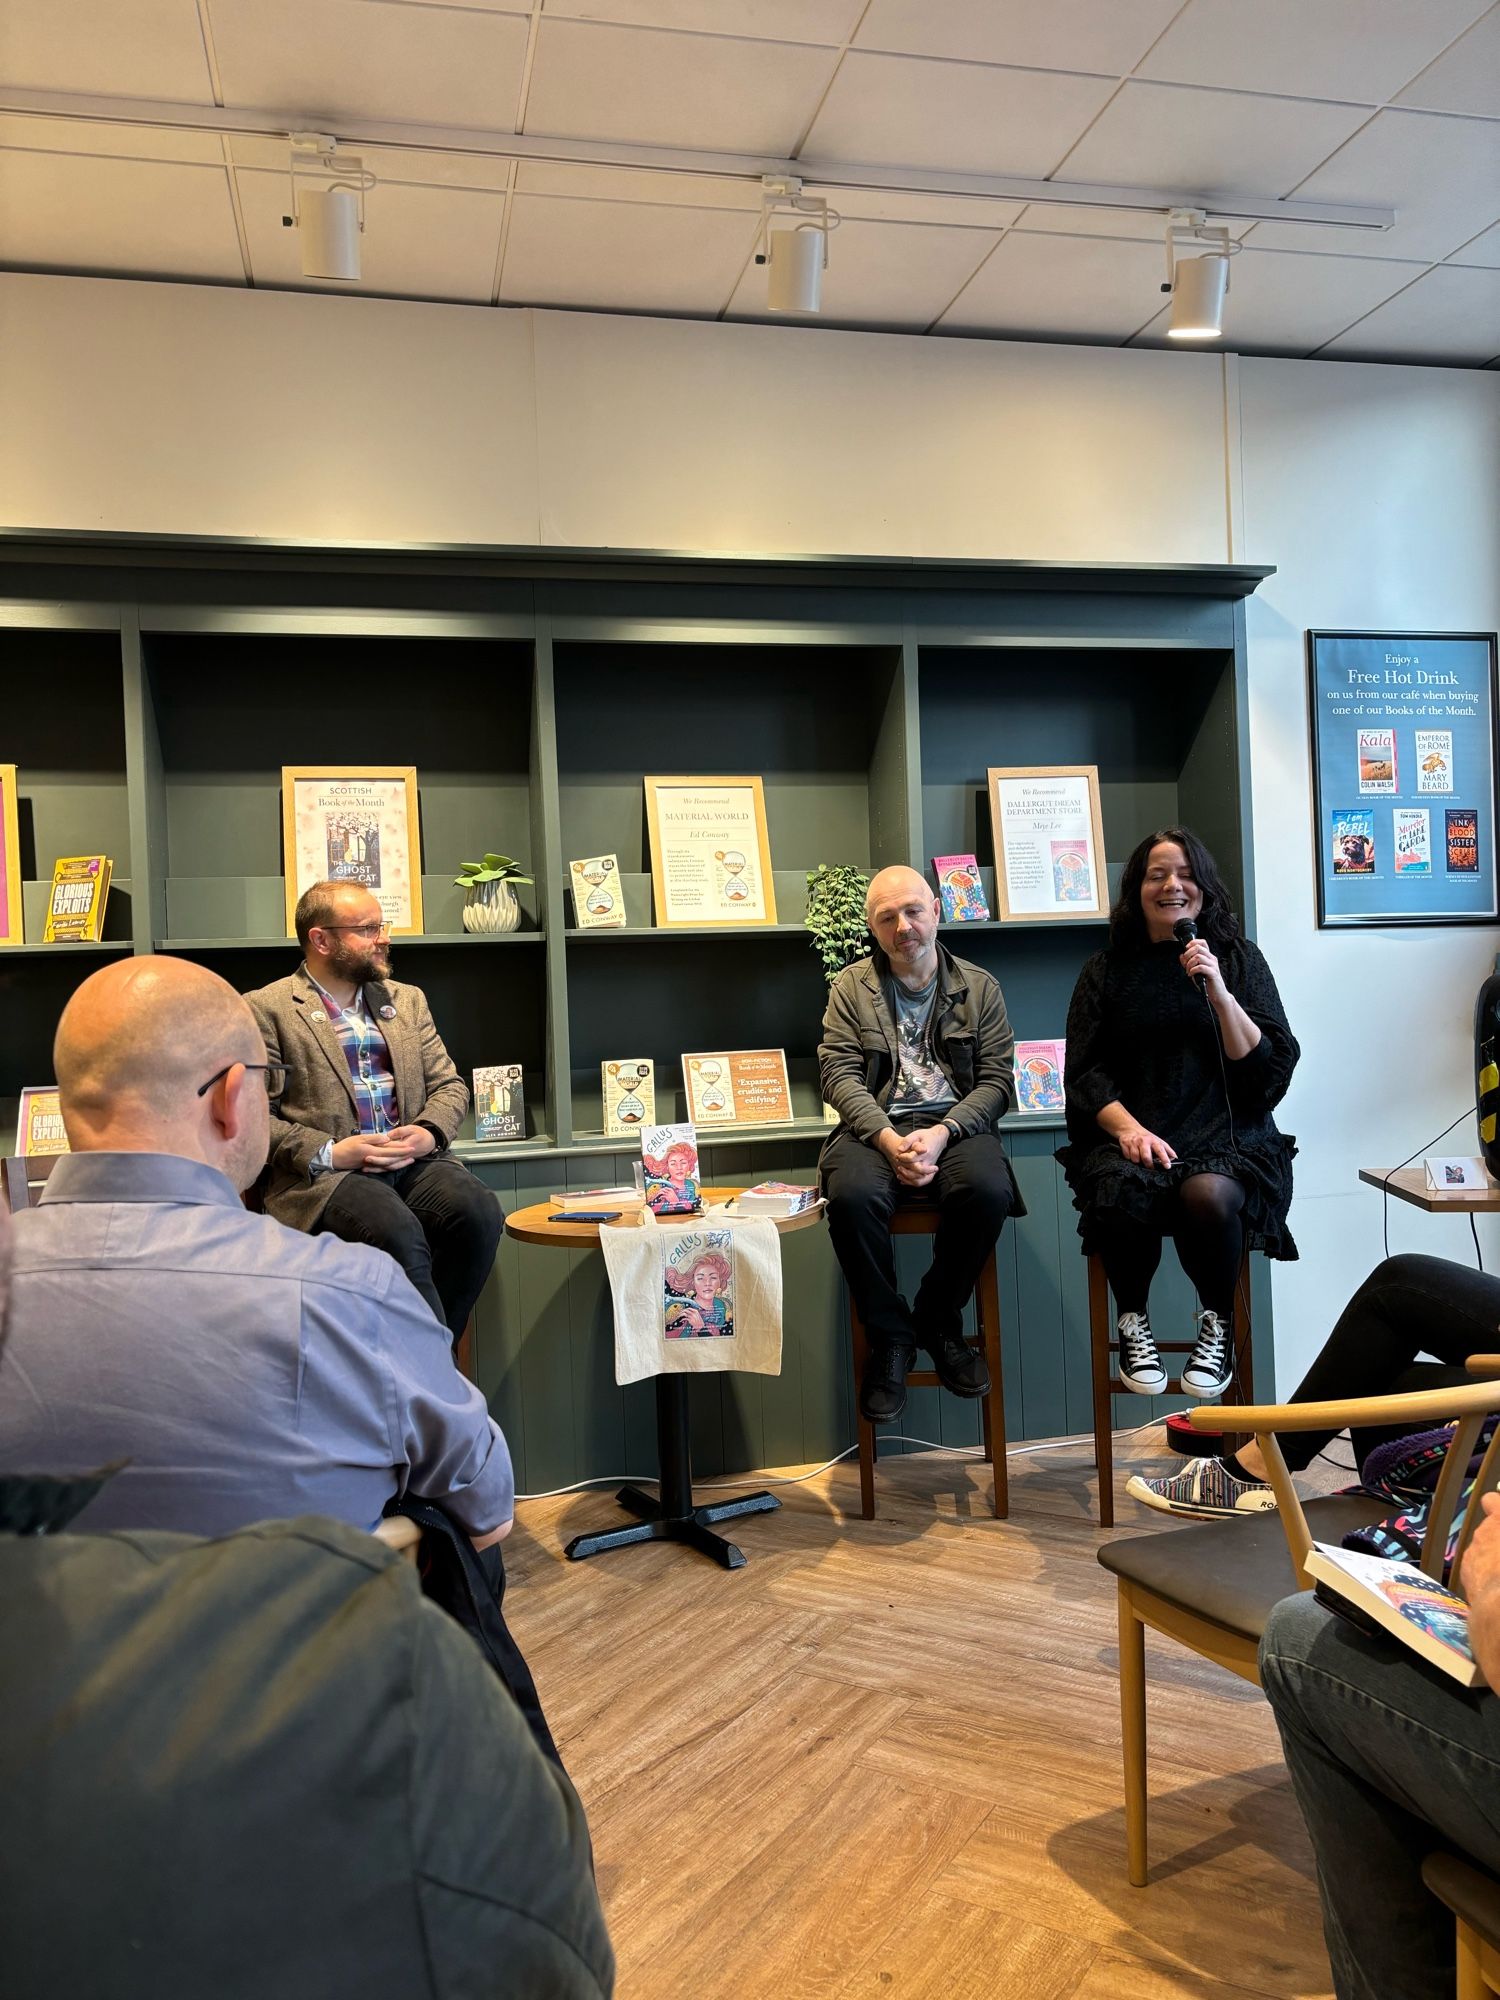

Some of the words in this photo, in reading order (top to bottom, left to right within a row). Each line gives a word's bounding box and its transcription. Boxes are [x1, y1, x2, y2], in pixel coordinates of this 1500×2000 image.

[1385, 654, 1411, 666] Enjoy
[1348, 669, 1380, 684] Free
[1384, 670, 1412, 684] Hot
[1416, 670, 1459, 685] Drink
[1356, 689, 1380, 699] from
[1400, 690, 1420, 700] café
[1422, 690, 1446, 700] when
[1448, 691, 1479, 703] buying
[1332, 707, 1351, 715] one
[1354, 705, 1364, 715] of
[1366, 707, 1383, 715] our
[1385, 705, 1414, 715] Books
[1416, 706, 1427, 715] of
[1428, 706, 1443, 715] the
[1446, 706, 1476, 716] Month.
[1360, 734, 1391, 746] Kala
[356, 798, 384, 806] Month
[1338, 822, 1370, 835] REBEL
[1399, 818, 1426, 833] Murder
[1398, 835, 1426, 852] GARDA
[1450, 838, 1475, 846] SISTER
[336, 866, 372, 874] GHOST
[54, 882, 94, 900] GLORIOUS
[52, 898, 91, 915] EXPLOITS
[737, 1087, 767, 1096] erudite,
[483, 1116, 516, 1126] GHOST
[504, 1123, 521, 1132] CAT
[647, 1127, 673, 1153] GALLUS
[670, 1233, 701, 1265] GALLUS
